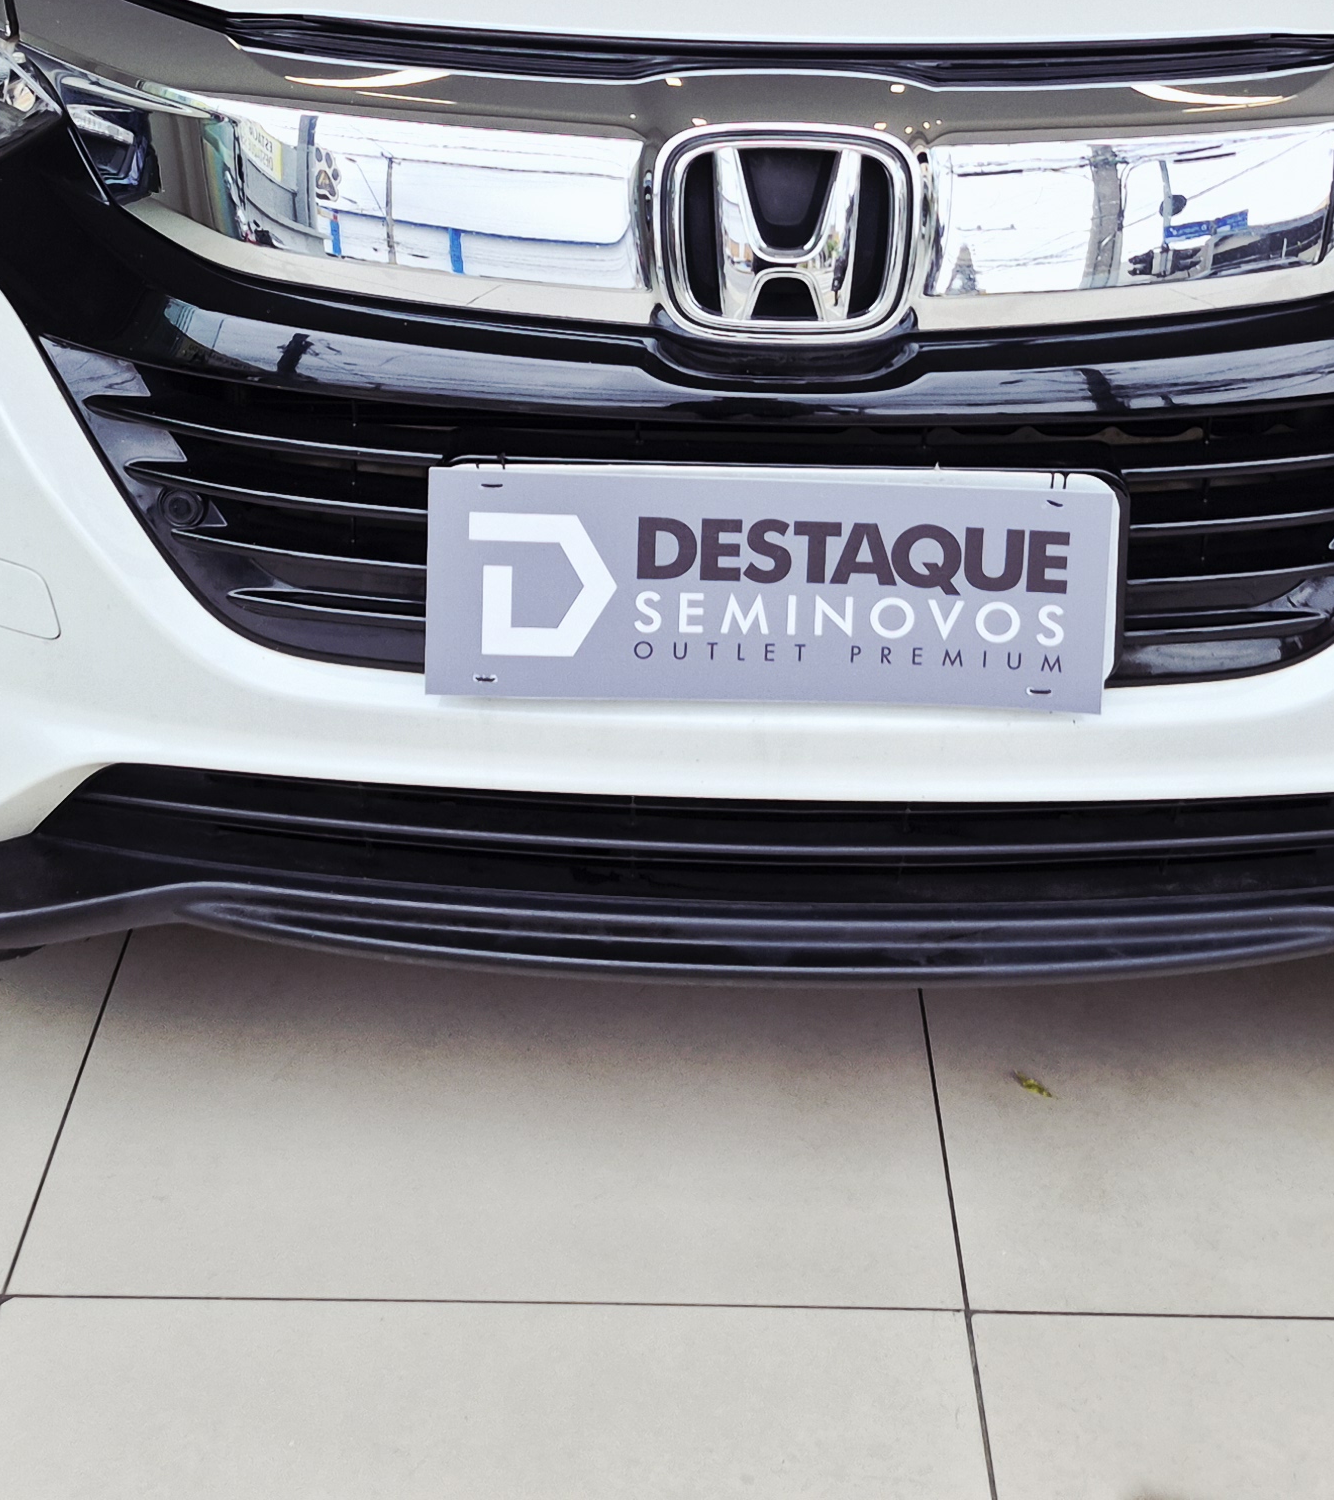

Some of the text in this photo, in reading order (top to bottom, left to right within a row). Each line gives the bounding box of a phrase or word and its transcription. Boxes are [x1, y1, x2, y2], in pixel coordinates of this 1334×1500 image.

[636, 516, 1071, 596] DESTAQUE
[633, 591, 1065, 649] SEMINOVOS
[633, 641, 1063, 674] OUTLET PREMIUM
